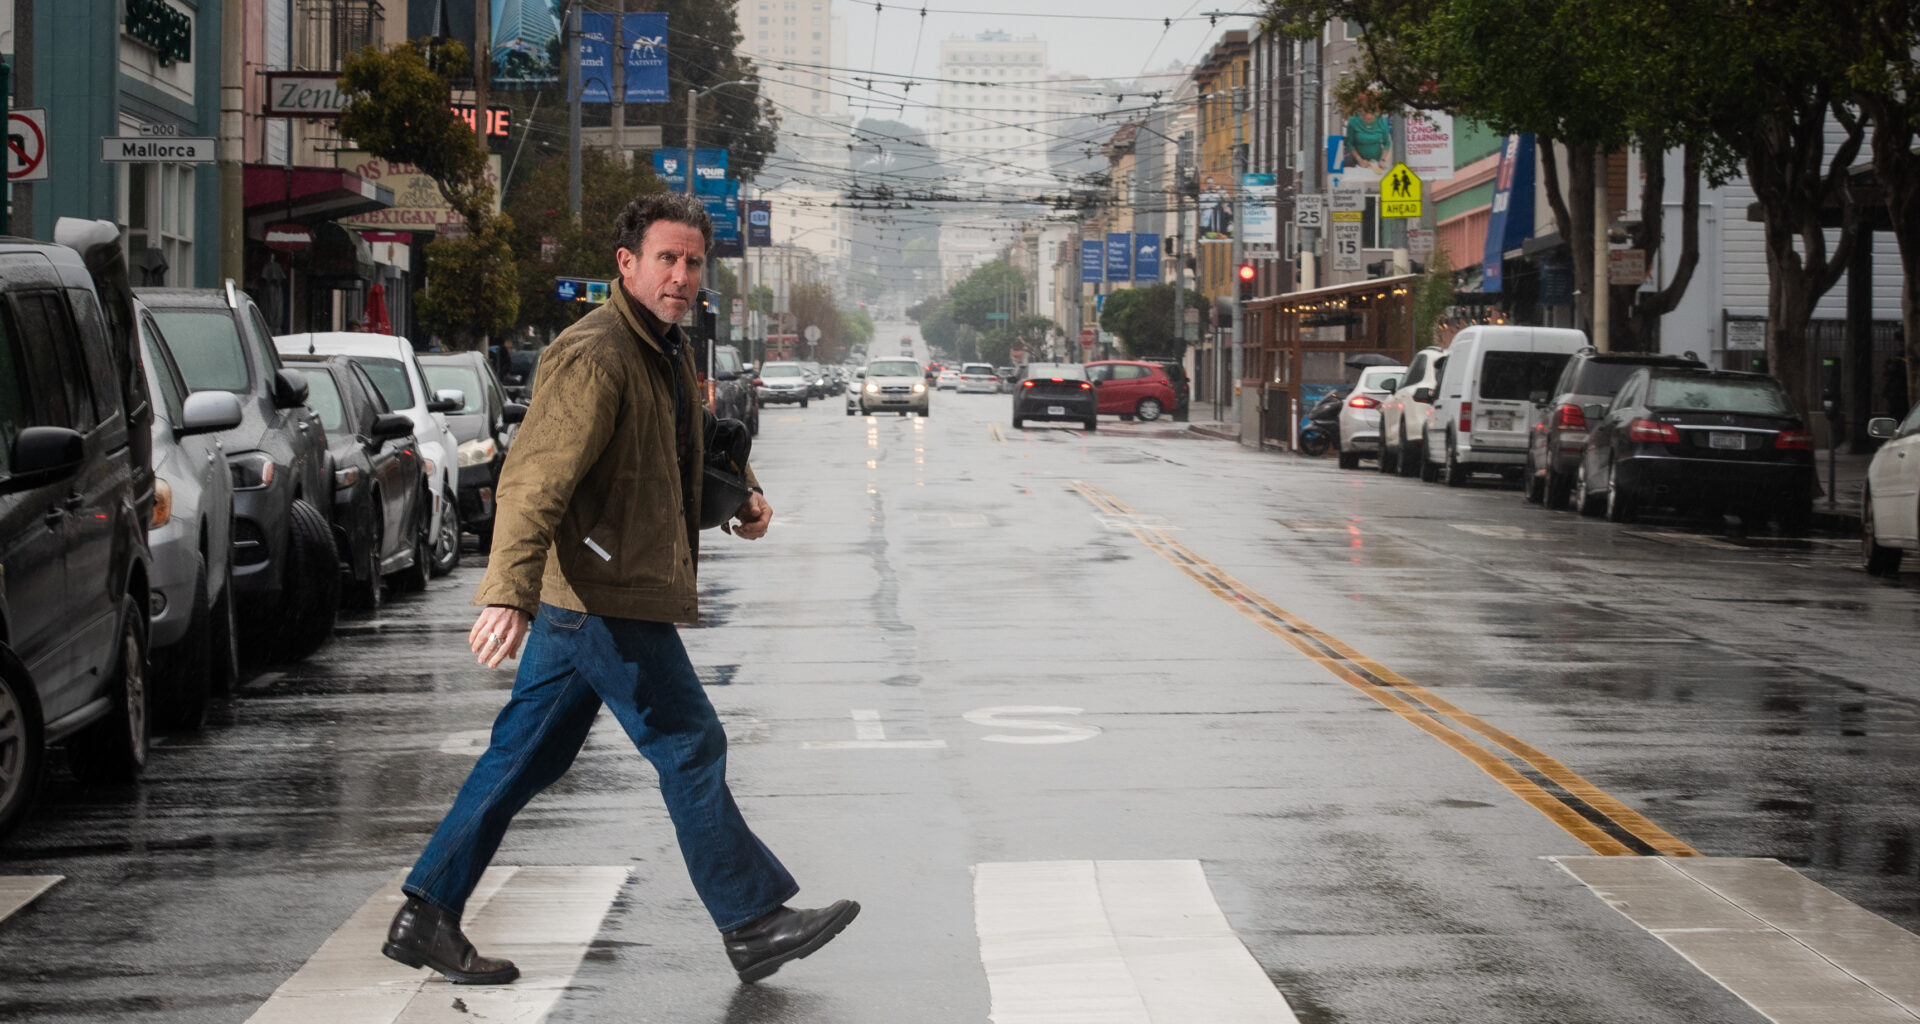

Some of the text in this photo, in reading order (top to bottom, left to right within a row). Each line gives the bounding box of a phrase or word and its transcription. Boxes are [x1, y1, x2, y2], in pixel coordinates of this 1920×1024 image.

[580, 56, 604, 66] amel
[277, 82, 350, 109] Zenb
[152, 125, 174, 135] 000
[1407, 133, 1449, 142] LEARNING
[122, 142, 195, 157] Mallorca
[696, 168, 725, 176] YOUR
[1386, 204, 1417, 214] AHEAD
[351, 210, 437, 224] MEXICAN
[1298, 211, 1320, 224] 25
[1338, 241, 1356, 254] 15
